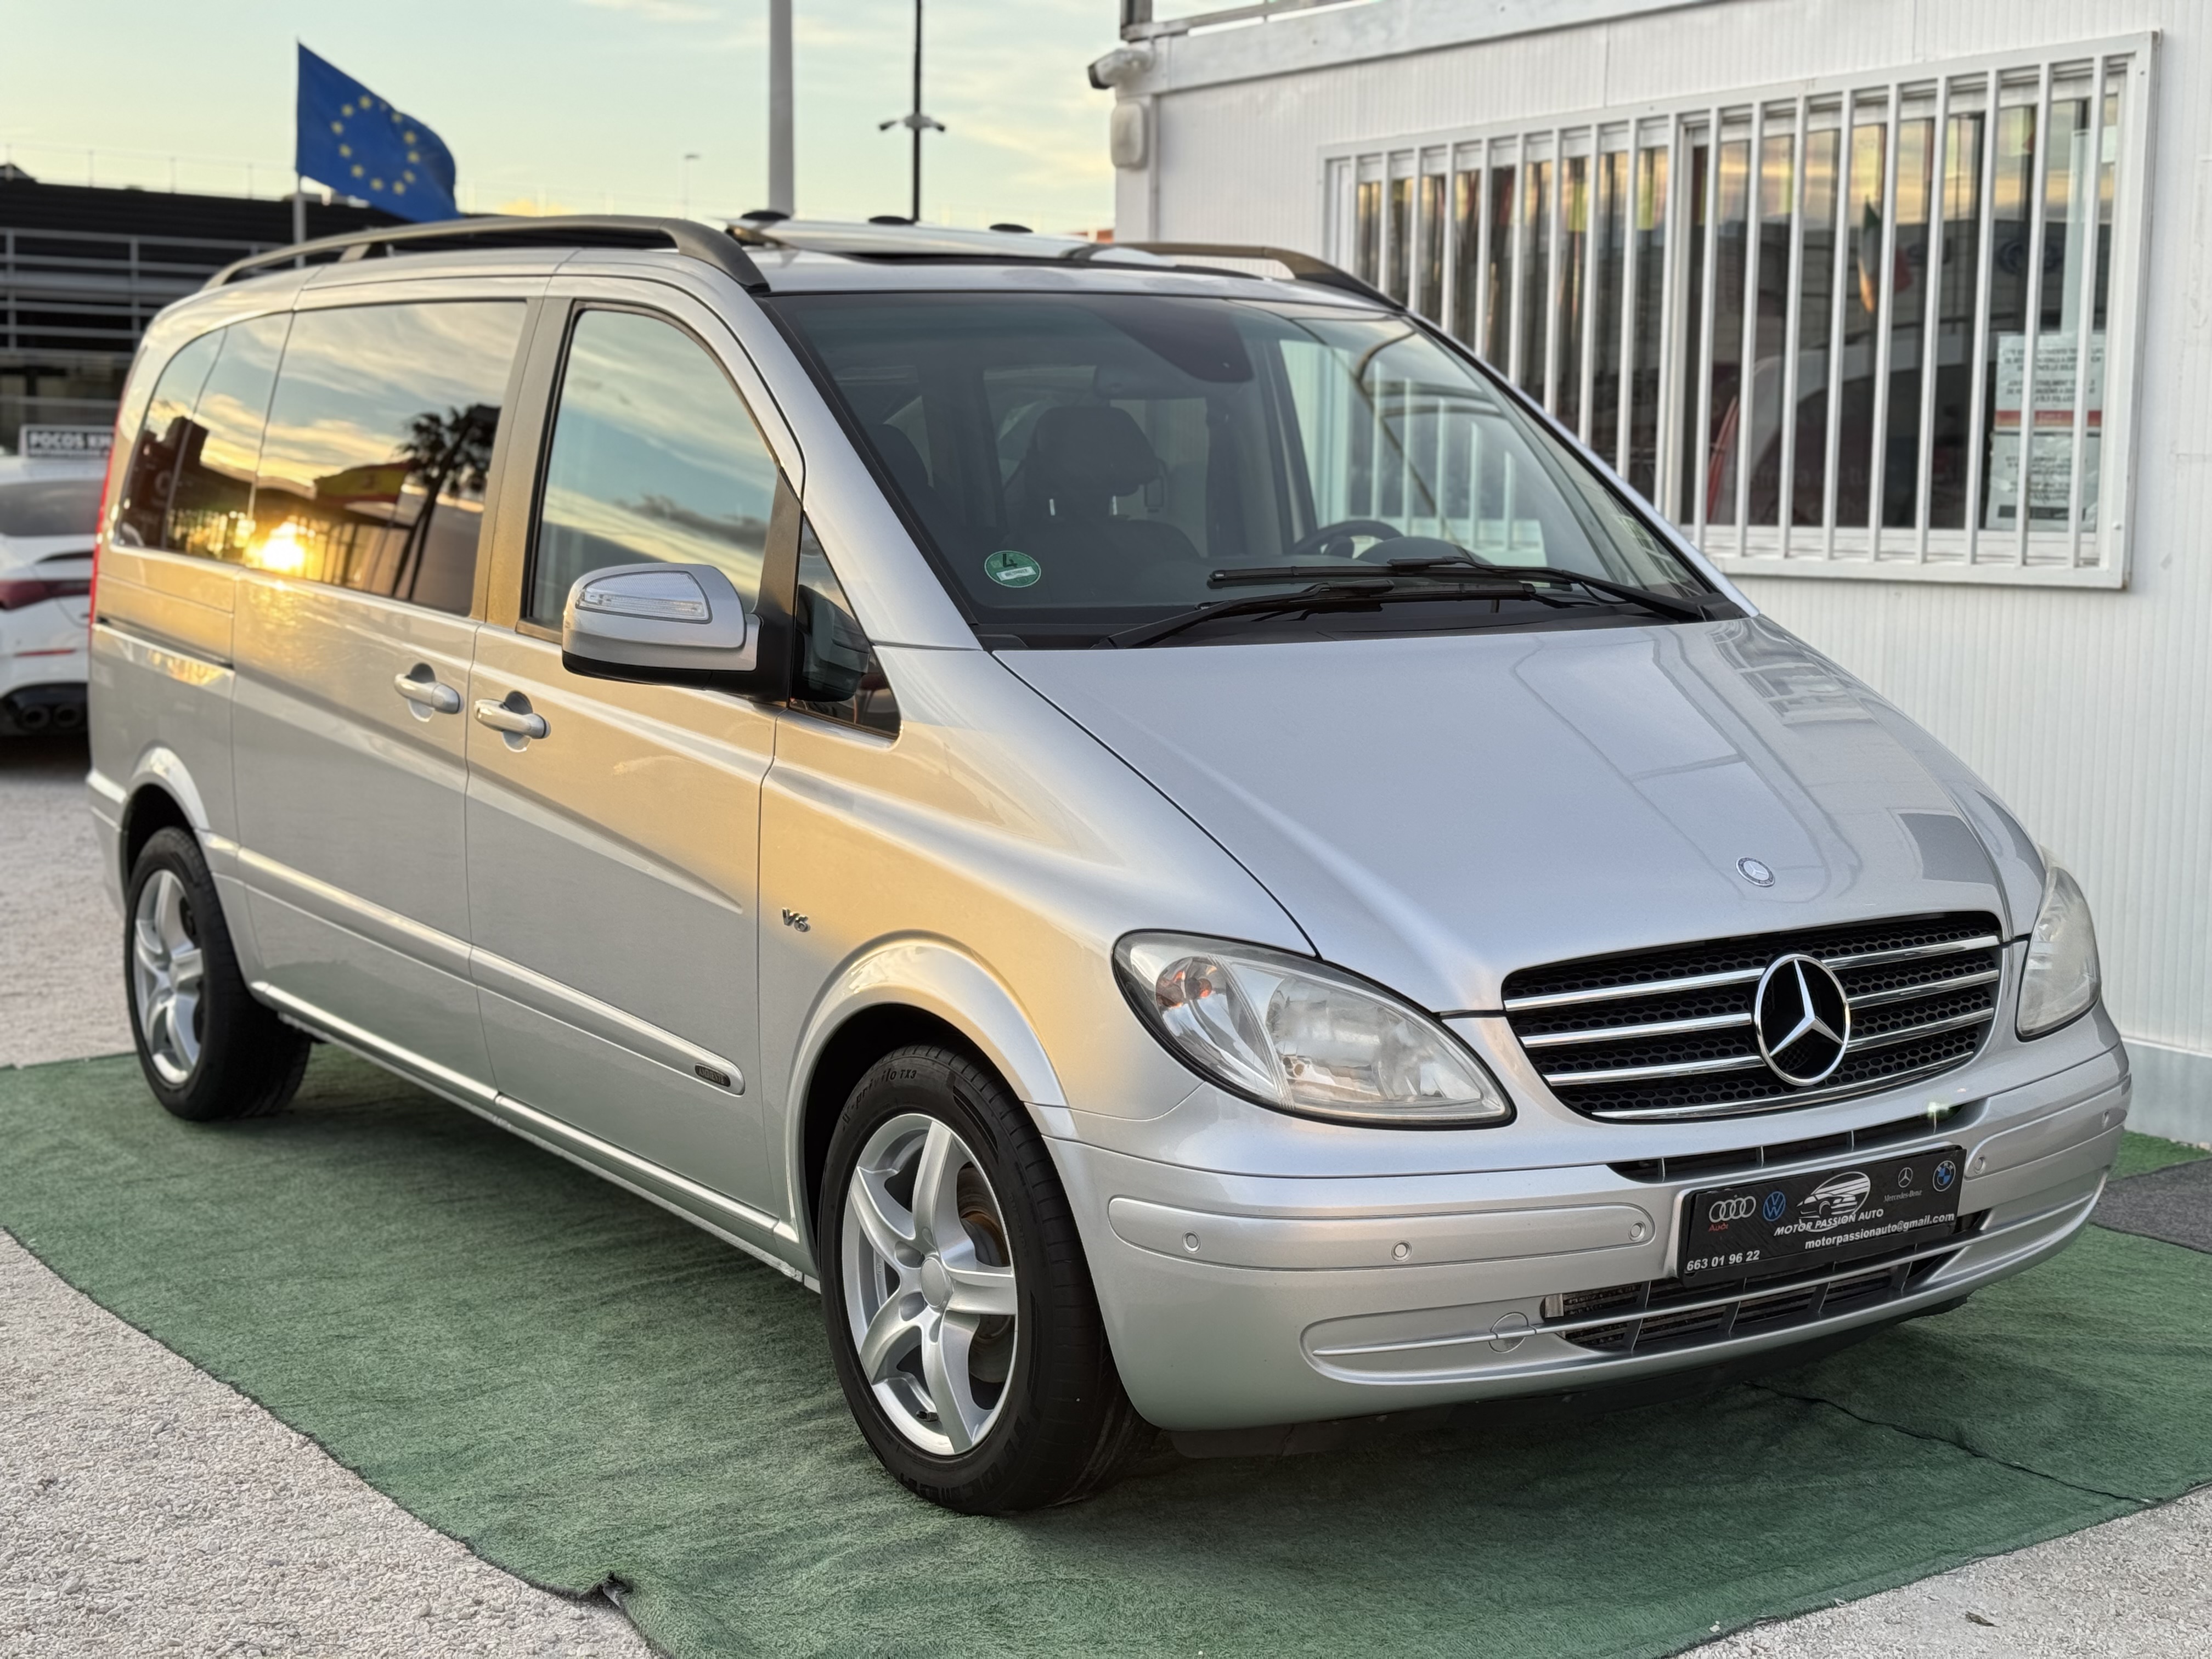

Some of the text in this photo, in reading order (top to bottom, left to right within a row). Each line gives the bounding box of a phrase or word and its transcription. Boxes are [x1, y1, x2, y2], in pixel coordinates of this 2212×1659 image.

[1002, 553, 1018, 568] 4
[782, 908, 811, 933] V6
[900, 1069, 917, 1080] TX3
[1883, 1189, 1922, 1203] Mercedes-Benz
[1708, 1222, 1729, 1232] Audi
[1774, 1208, 1884, 1237] MOTOR PASSION AUTO
[1804, 1213, 1955, 1250] motorpassionauto@gmail.com
[1686, 1249, 1760, 1271] 663 01 96 22
